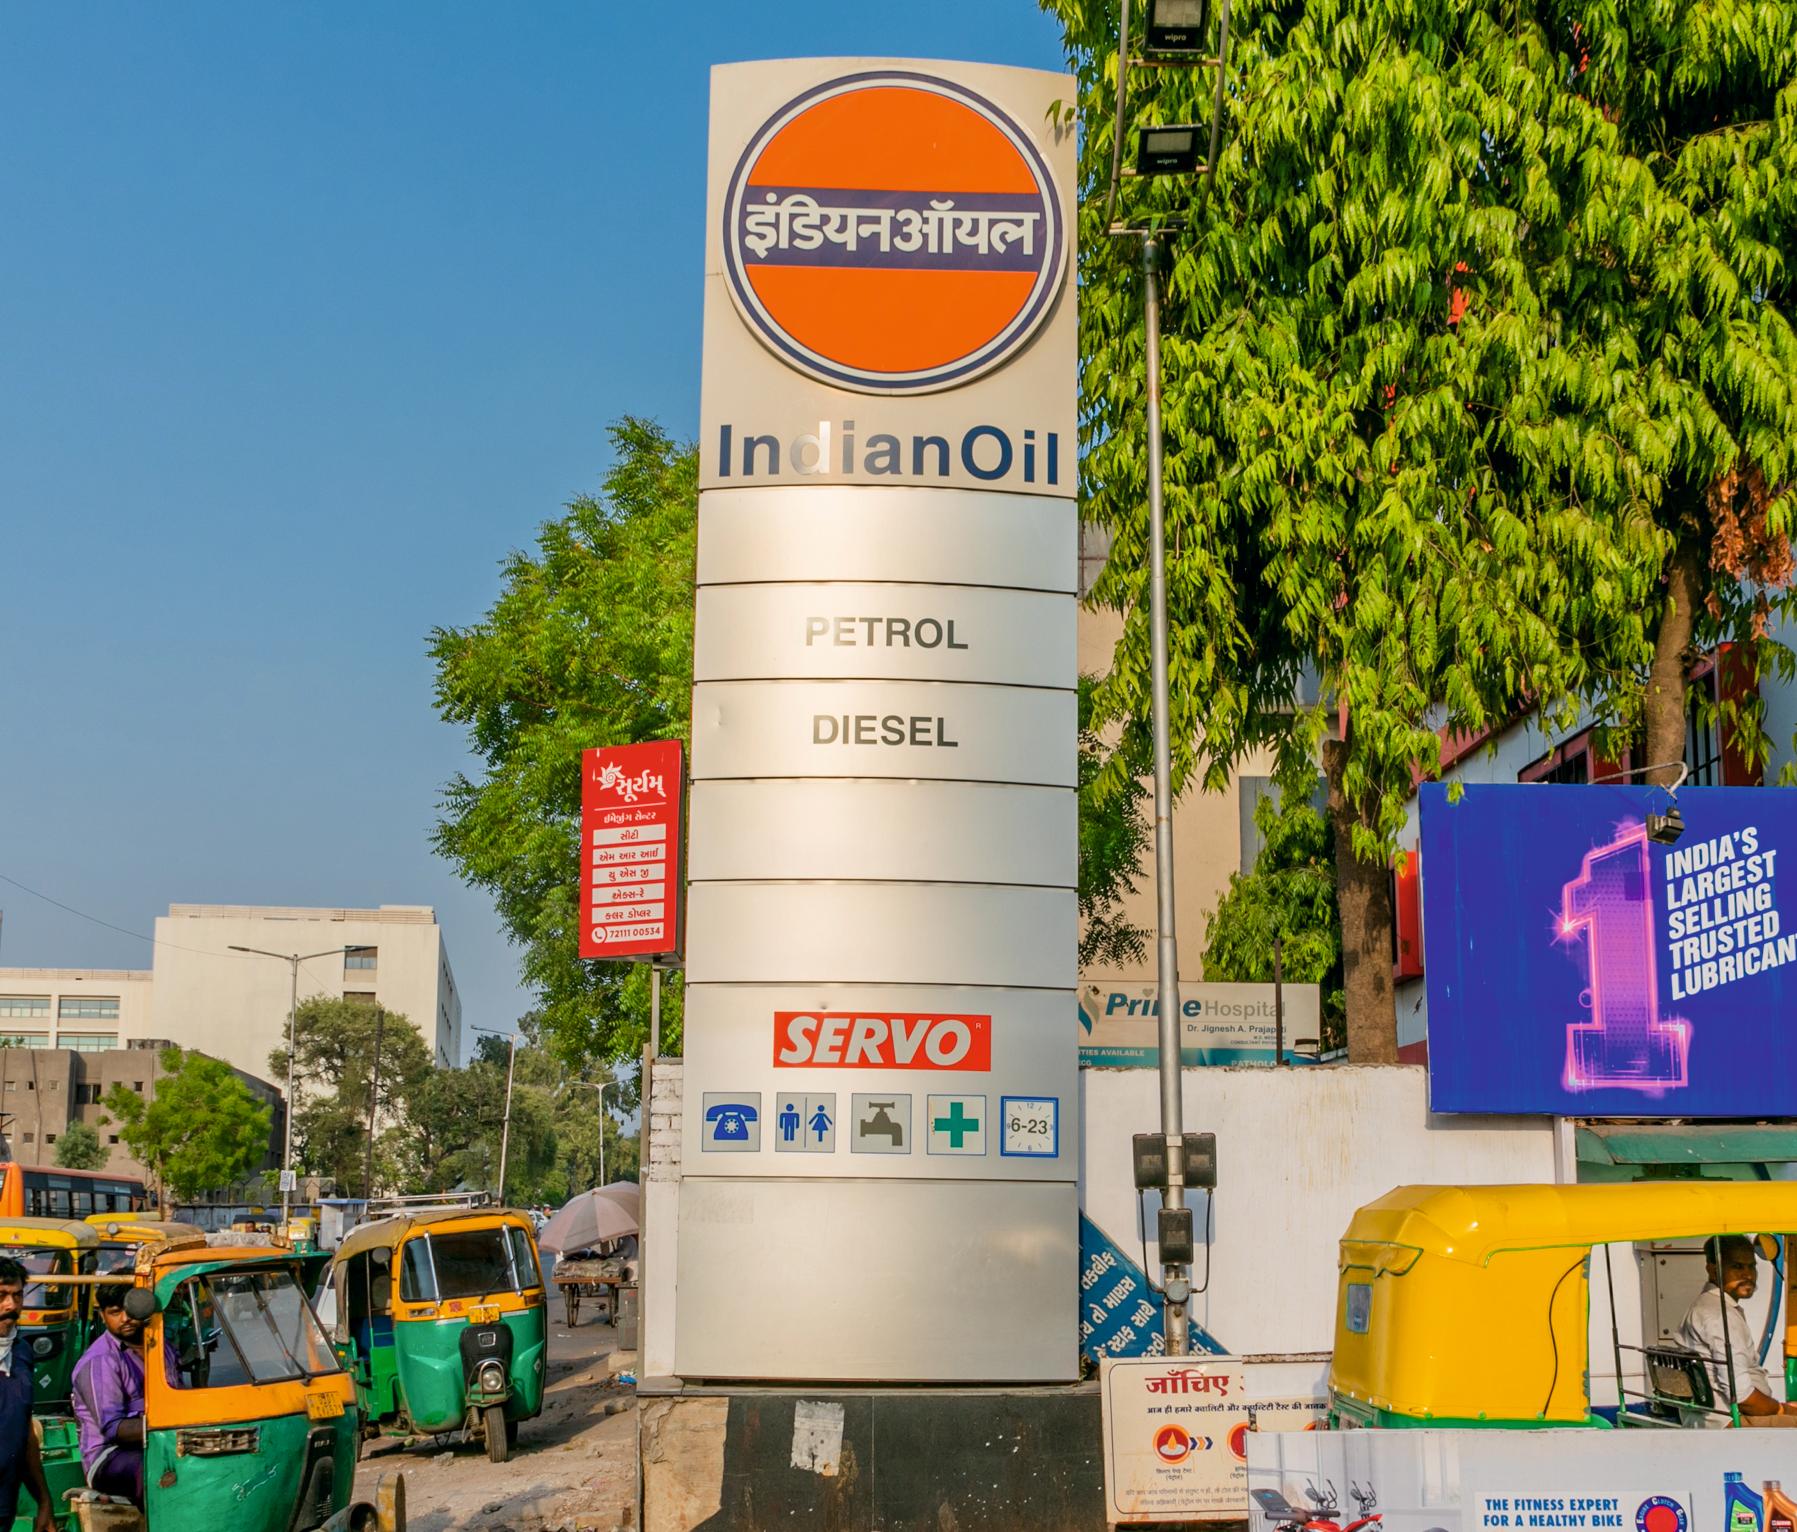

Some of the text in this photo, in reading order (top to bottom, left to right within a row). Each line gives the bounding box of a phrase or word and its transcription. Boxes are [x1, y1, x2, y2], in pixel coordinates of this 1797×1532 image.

[1165, 33, 1186, 41] wipro
[745, 192, 1040, 259] इंडियनऑयल
[718, 420, 1058, 485] IndianOil
[805, 616, 969, 649] PETROL
[811, 714, 959, 748] DIESEL
[620, 829, 639, 840] સીટી
[600, 851, 615, 861] એમ
[619, 852, 636, 860] આર
[1665, 826, 1758, 881] INDIA'S
[620, 867, 636, 878] એસ
[1667, 850, 1777, 911] LARGEST
[1668, 882, 1772, 940] SELLING
[610, 927, 660, 938] 72111 00534
[1669, 910, 1780, 970] TRUSTED
[1671, 933, 1797, 1001] LUBRICAN
[1106, 993, 1201, 1018] Prie
[779, 1016, 971, 1066] SERVO
[1201, 1025, 1235, 1034] Jignesh
[1011, 1117, 1048, 1134] 6-23
[1145, 1369, 1230, 1397] जाँचिए
[1485, 1498, 1619, 1511] THE FITNESS EXPERT
[1483, 1514, 1623, 1527] FOR A HEALTHY BIKE
